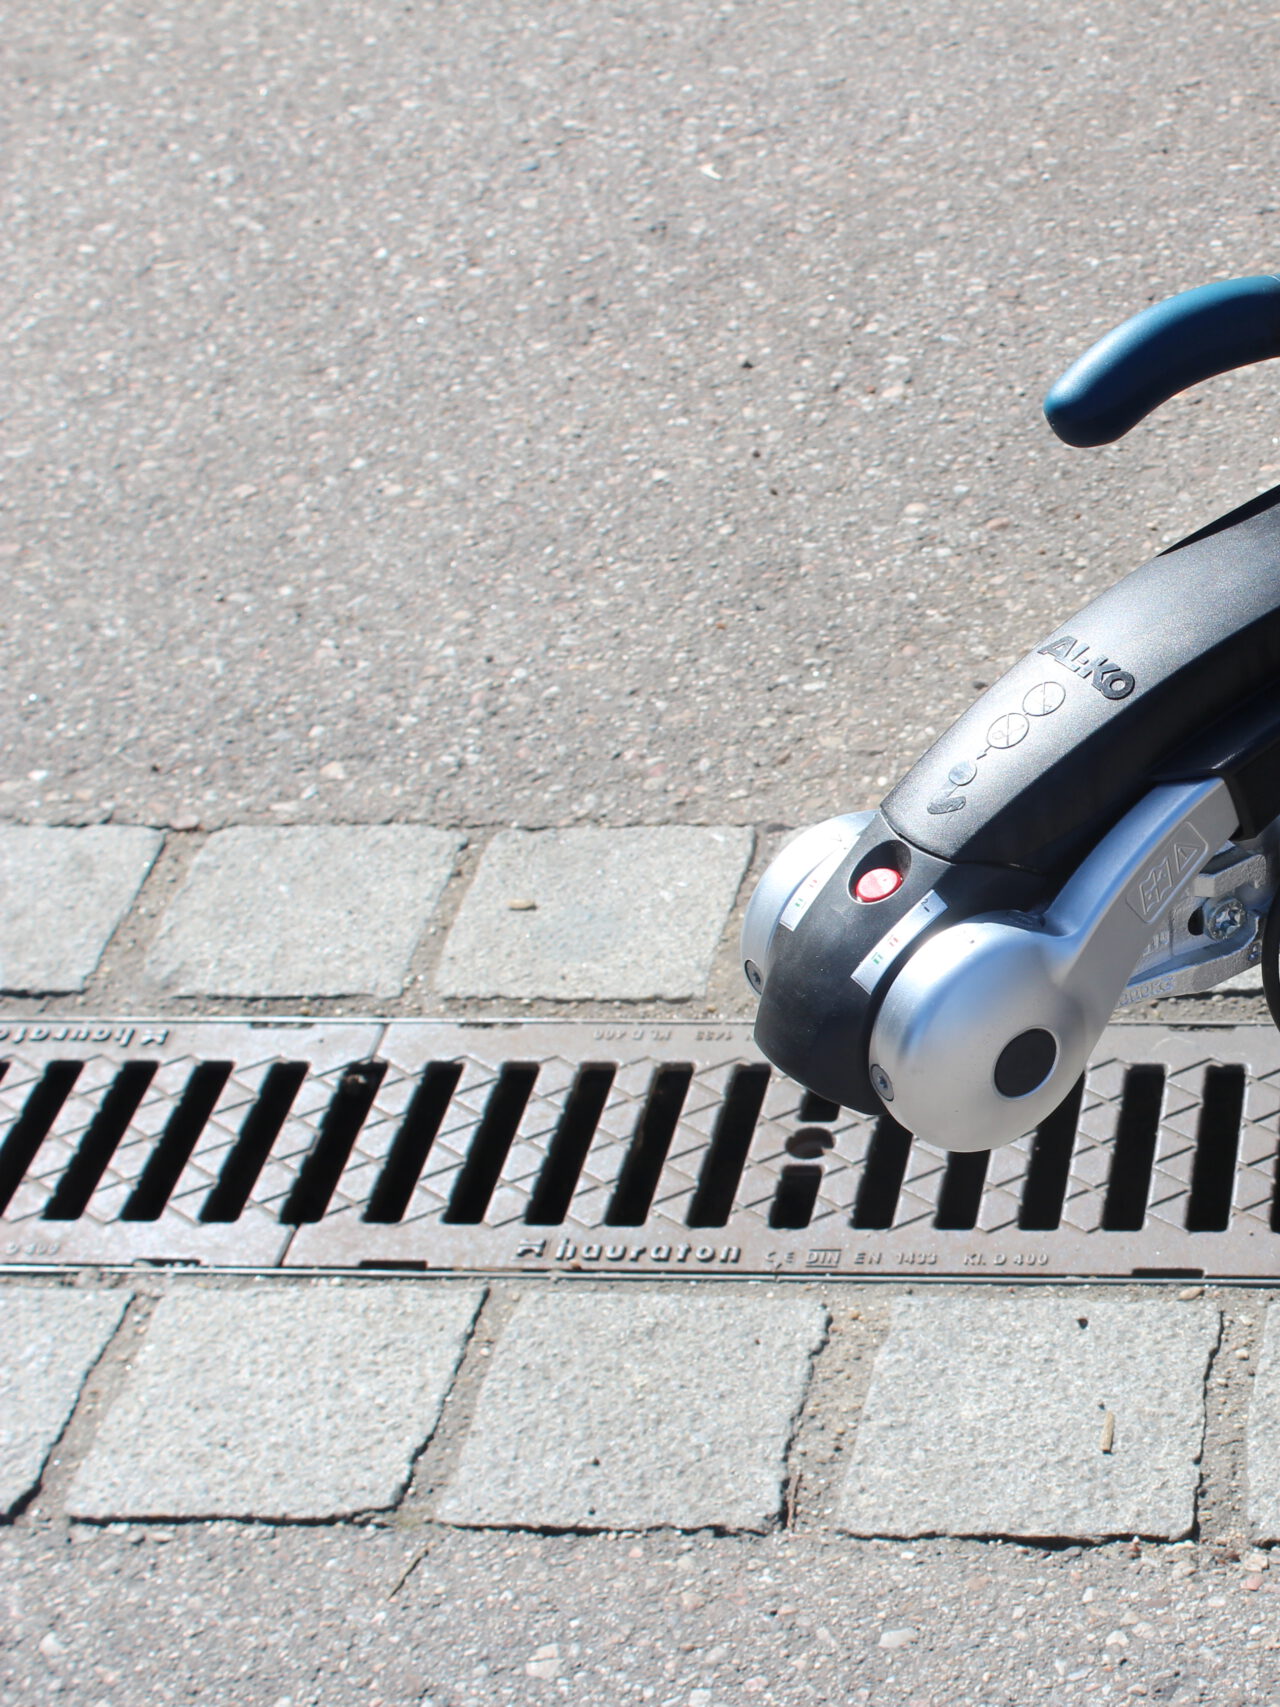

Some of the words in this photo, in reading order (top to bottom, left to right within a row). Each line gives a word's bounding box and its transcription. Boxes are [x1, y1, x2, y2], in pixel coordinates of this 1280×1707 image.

[1037, 635, 1136, 700] AL-KO
[556, 1238, 742, 1263] hauraton
[805, 1249, 842, 1268] DIN
[854, 1252, 883, 1265] EN
[896, 1253, 938, 1265] 1433
[993, 1253, 1008, 1266] D
[1013, 1253, 1049, 1266] 400
